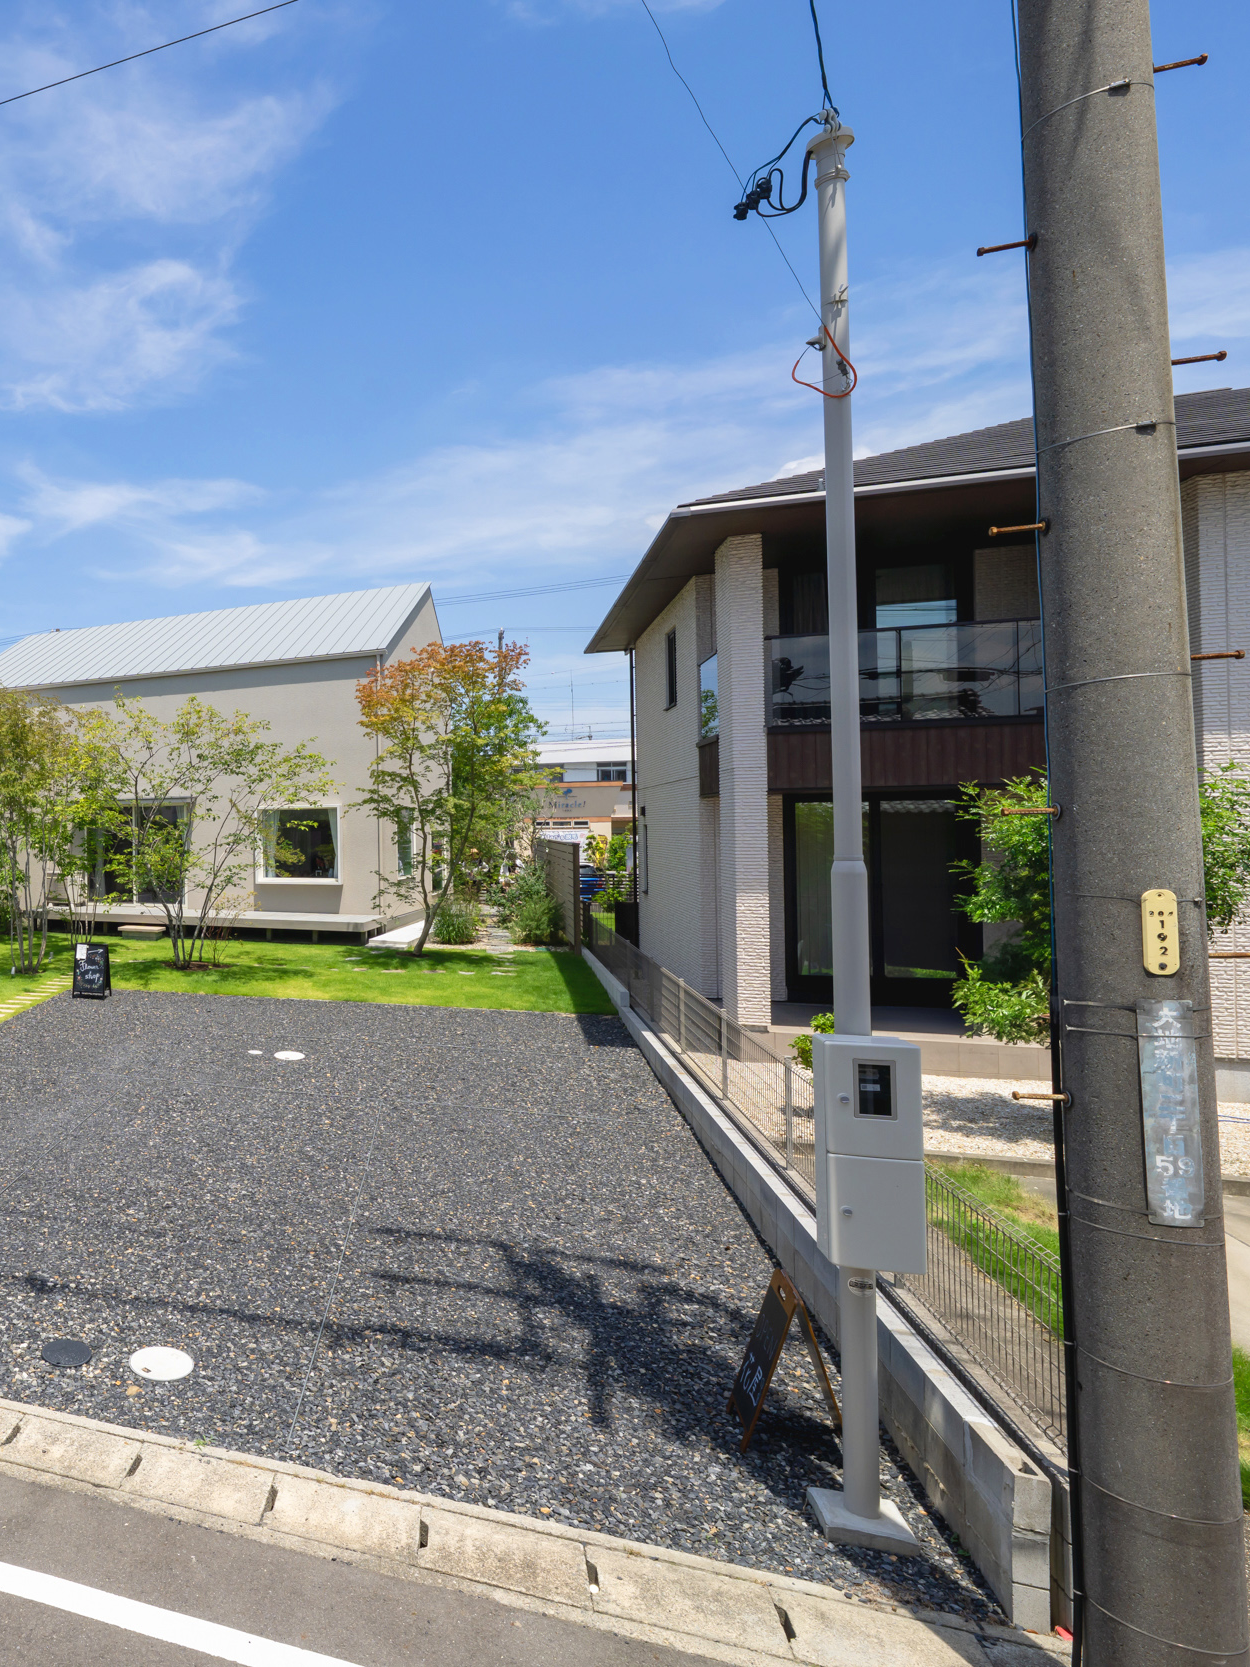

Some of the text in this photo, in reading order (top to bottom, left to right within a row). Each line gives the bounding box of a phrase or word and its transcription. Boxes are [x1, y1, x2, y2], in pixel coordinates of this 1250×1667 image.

[1157, 919, 1169, 956] 192
[78, 960, 99, 971] Flower
[85, 971, 100, 982] shop
